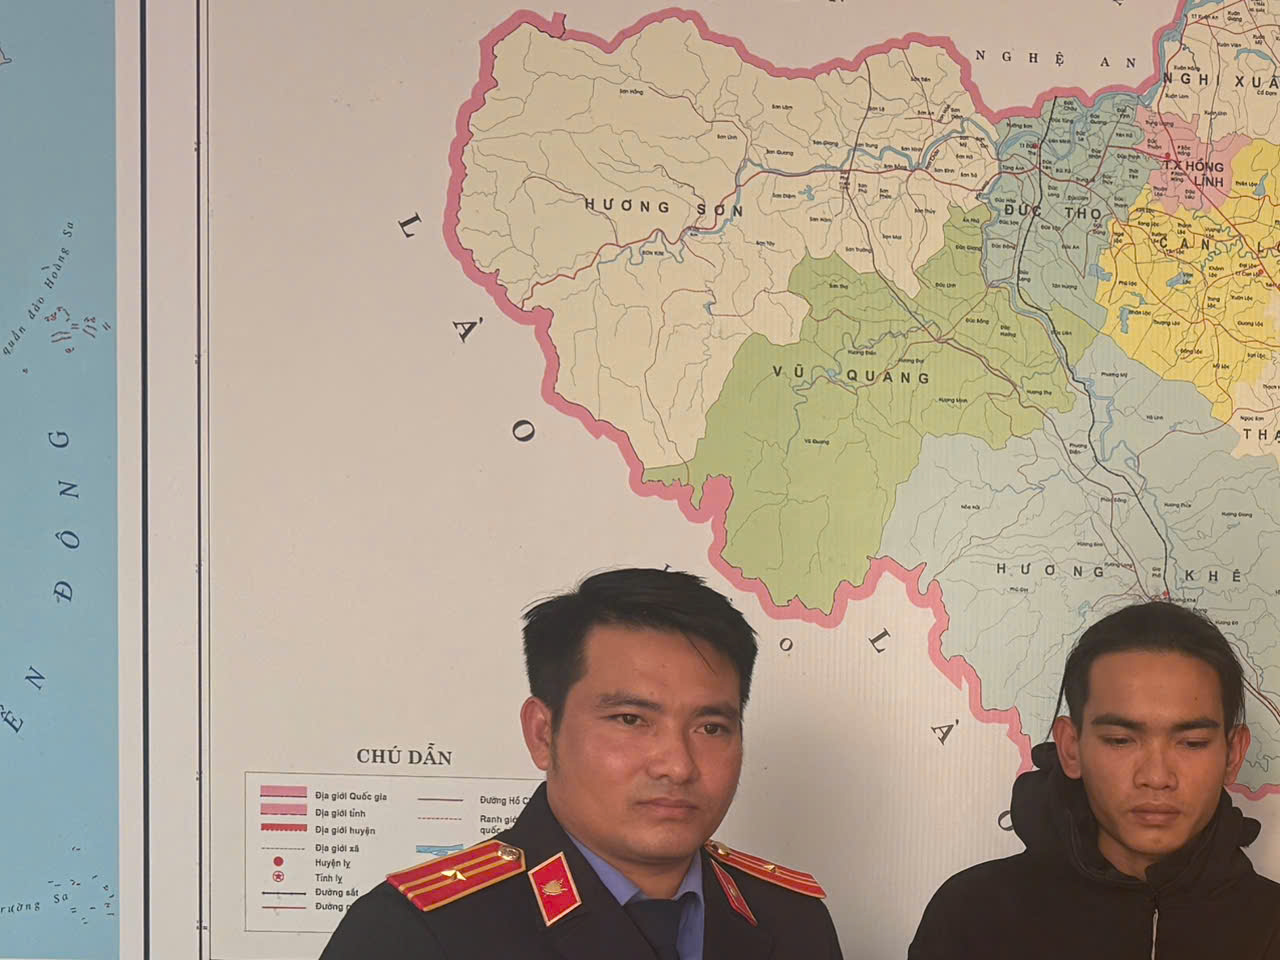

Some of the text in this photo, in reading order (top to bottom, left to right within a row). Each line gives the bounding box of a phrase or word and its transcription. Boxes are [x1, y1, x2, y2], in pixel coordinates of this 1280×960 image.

[976, 49, 1136, 68] NGHỆ AN
[585, 198, 743, 217] HƯƠNG SƠN
[772, 363, 930, 385] VŨ QUANG
[997, 562, 1241, 582] HƯƠNG KHÊ
[357, 742, 452, 765] CHÚ DẪN
[349, 791, 371, 802] Quốc
[480, 815, 502, 823] Ranh
